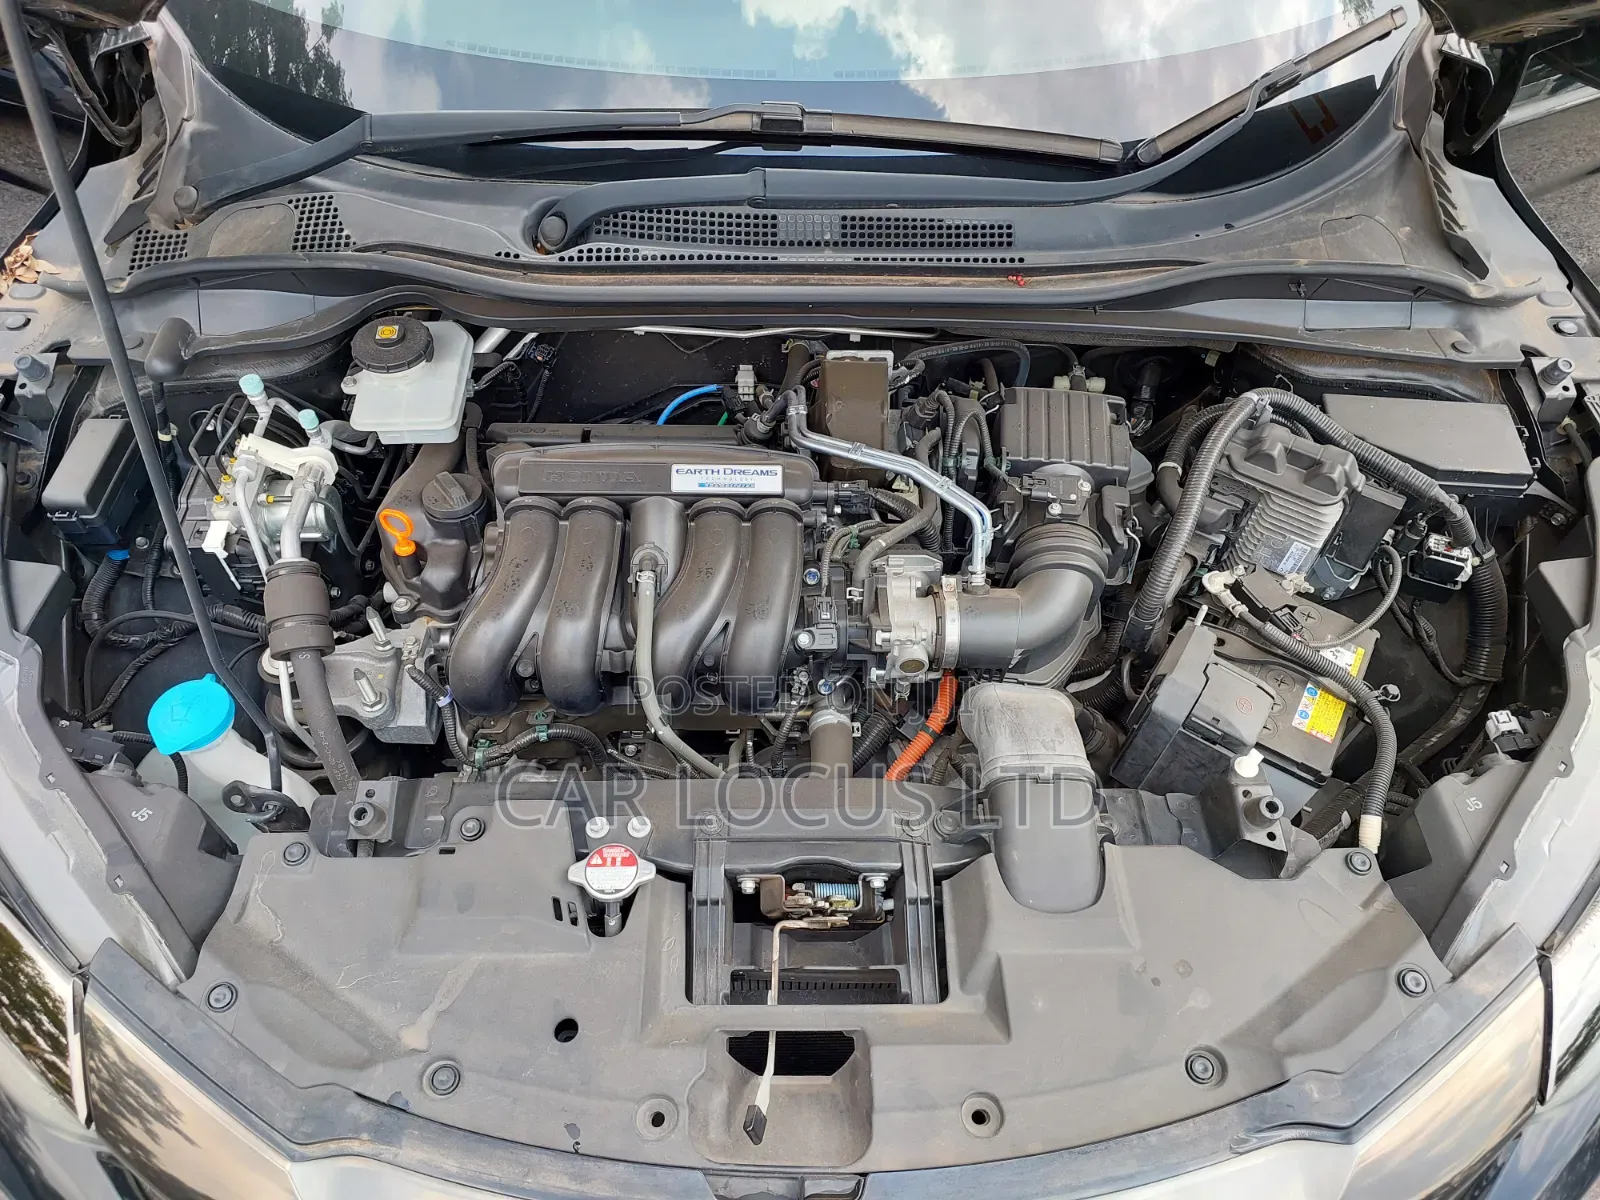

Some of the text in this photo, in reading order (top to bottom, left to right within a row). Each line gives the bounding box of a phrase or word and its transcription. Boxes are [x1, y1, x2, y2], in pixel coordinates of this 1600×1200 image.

[542, 468, 643, 484] HONDA
[675, 467, 778, 477] EARTH DREAMS
